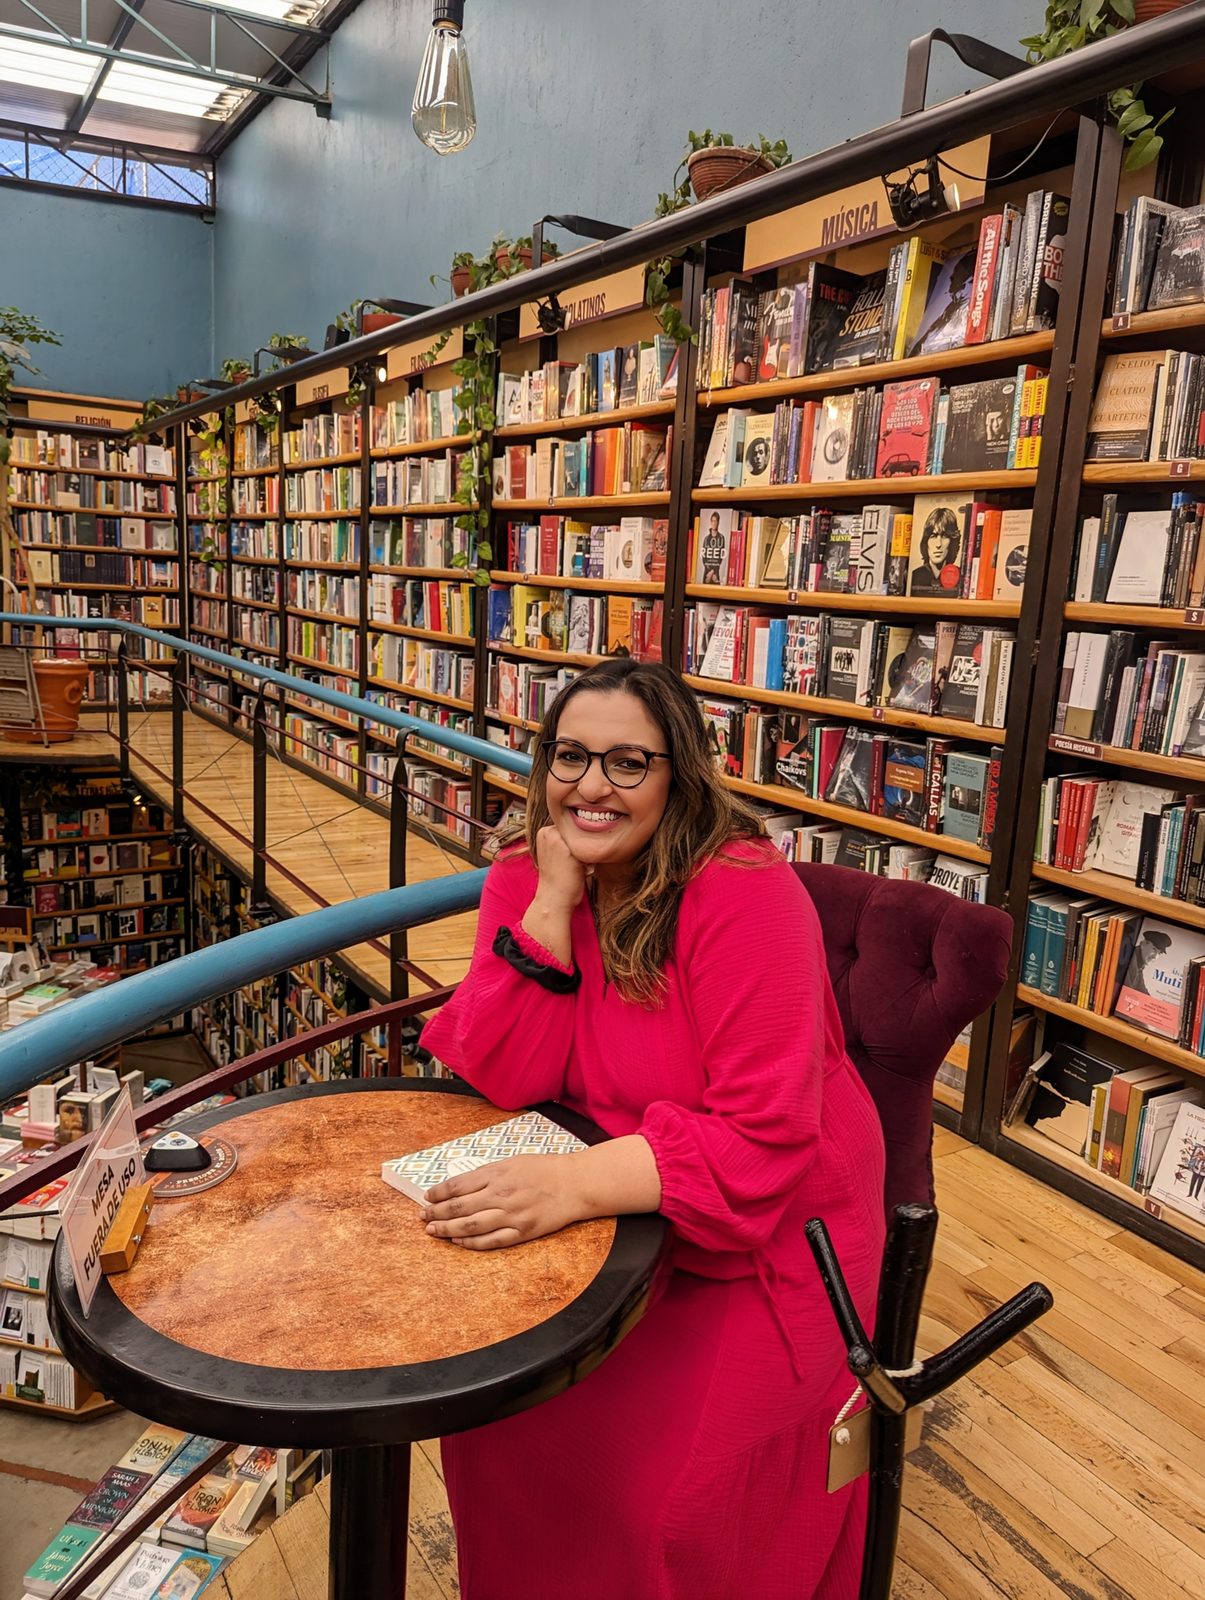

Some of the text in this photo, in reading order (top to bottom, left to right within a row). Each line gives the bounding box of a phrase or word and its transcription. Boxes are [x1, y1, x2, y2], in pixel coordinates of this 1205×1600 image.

[821, 201, 879, 247] MÚSICA
[984, 229, 996, 251] All
[1030, 262, 1042, 299] BRONX
[972, 280, 988, 327] Songs
[1117, 317, 1124, 327] A
[1127, 359, 1156, 369] ELIOT
[1109, 386, 1146, 396] CUATRO
[1094, 411, 1148, 422] CUARTETOS
[705, 536, 726, 548] LOU
[701, 548, 727, 559] REED
[858, 509, 880, 592] ELVIS
[1191, 611, 1198, 621] S
[1055, 739, 1096, 755] POESÍA HISPANA
[929, 772, 941, 817] CALLAS
[91, 1164, 114, 1217] MESA
[83, 1157, 136, 1280] FUERA DE USO
[140, 1438, 172, 1454] WING
[134, 1447, 168, 1460] FOURTH
[112, 1472, 134, 1481] SARAH
[112, 1479, 131, 1488] MAAS
[98, 1487, 130, 1500] CROWN
[193, 1491, 222, 1505] IRON
[81, 1501, 121, 1516] MIDNIGHT
[185, 1501, 218, 1514] FLAME
[59, 1534, 88, 1548] Ulysses
[46, 1551, 72, 1563] James
[39, 1560, 64, 1572] Joyce
